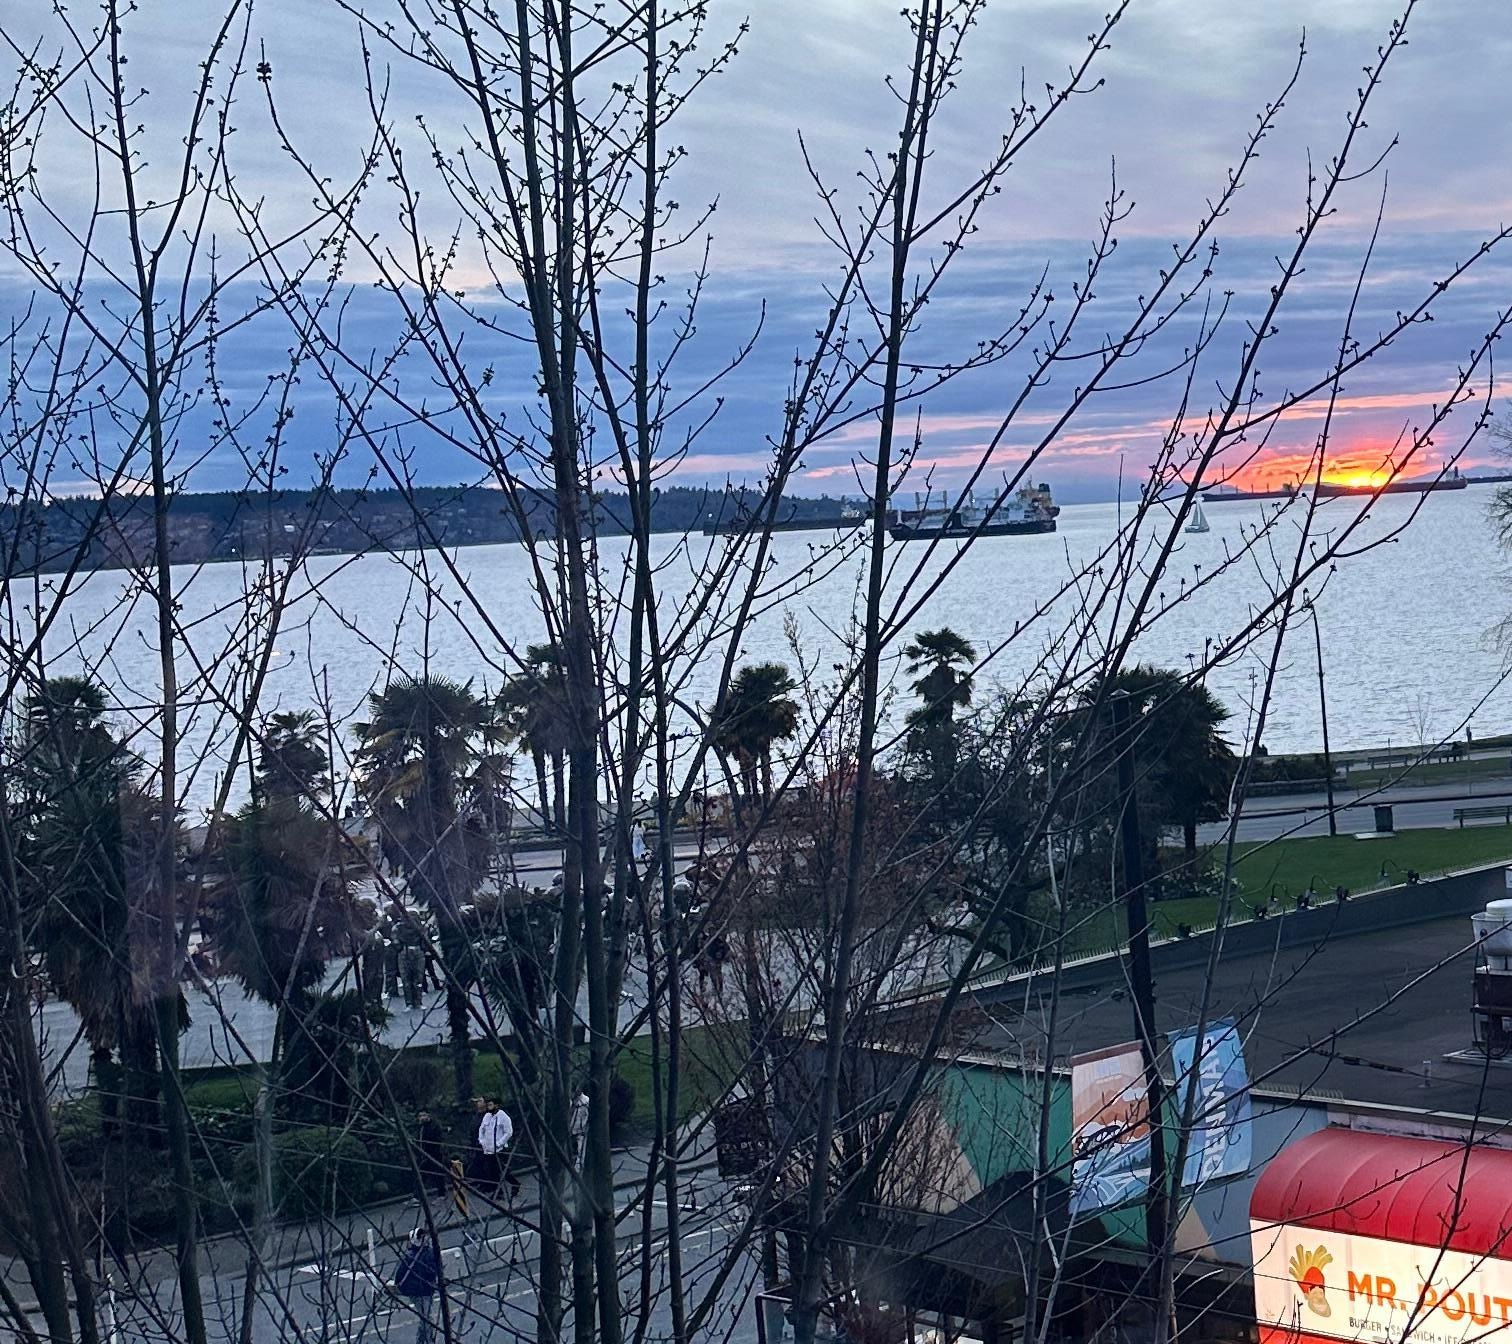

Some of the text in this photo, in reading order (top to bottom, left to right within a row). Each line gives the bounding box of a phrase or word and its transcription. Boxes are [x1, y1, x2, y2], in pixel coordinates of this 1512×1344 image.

[1347, 1270, 1406, 1311] MR.
[1349, 1316, 1382, 1333] BURGER
[1391, 1324, 1435, 1343] SAWICH
